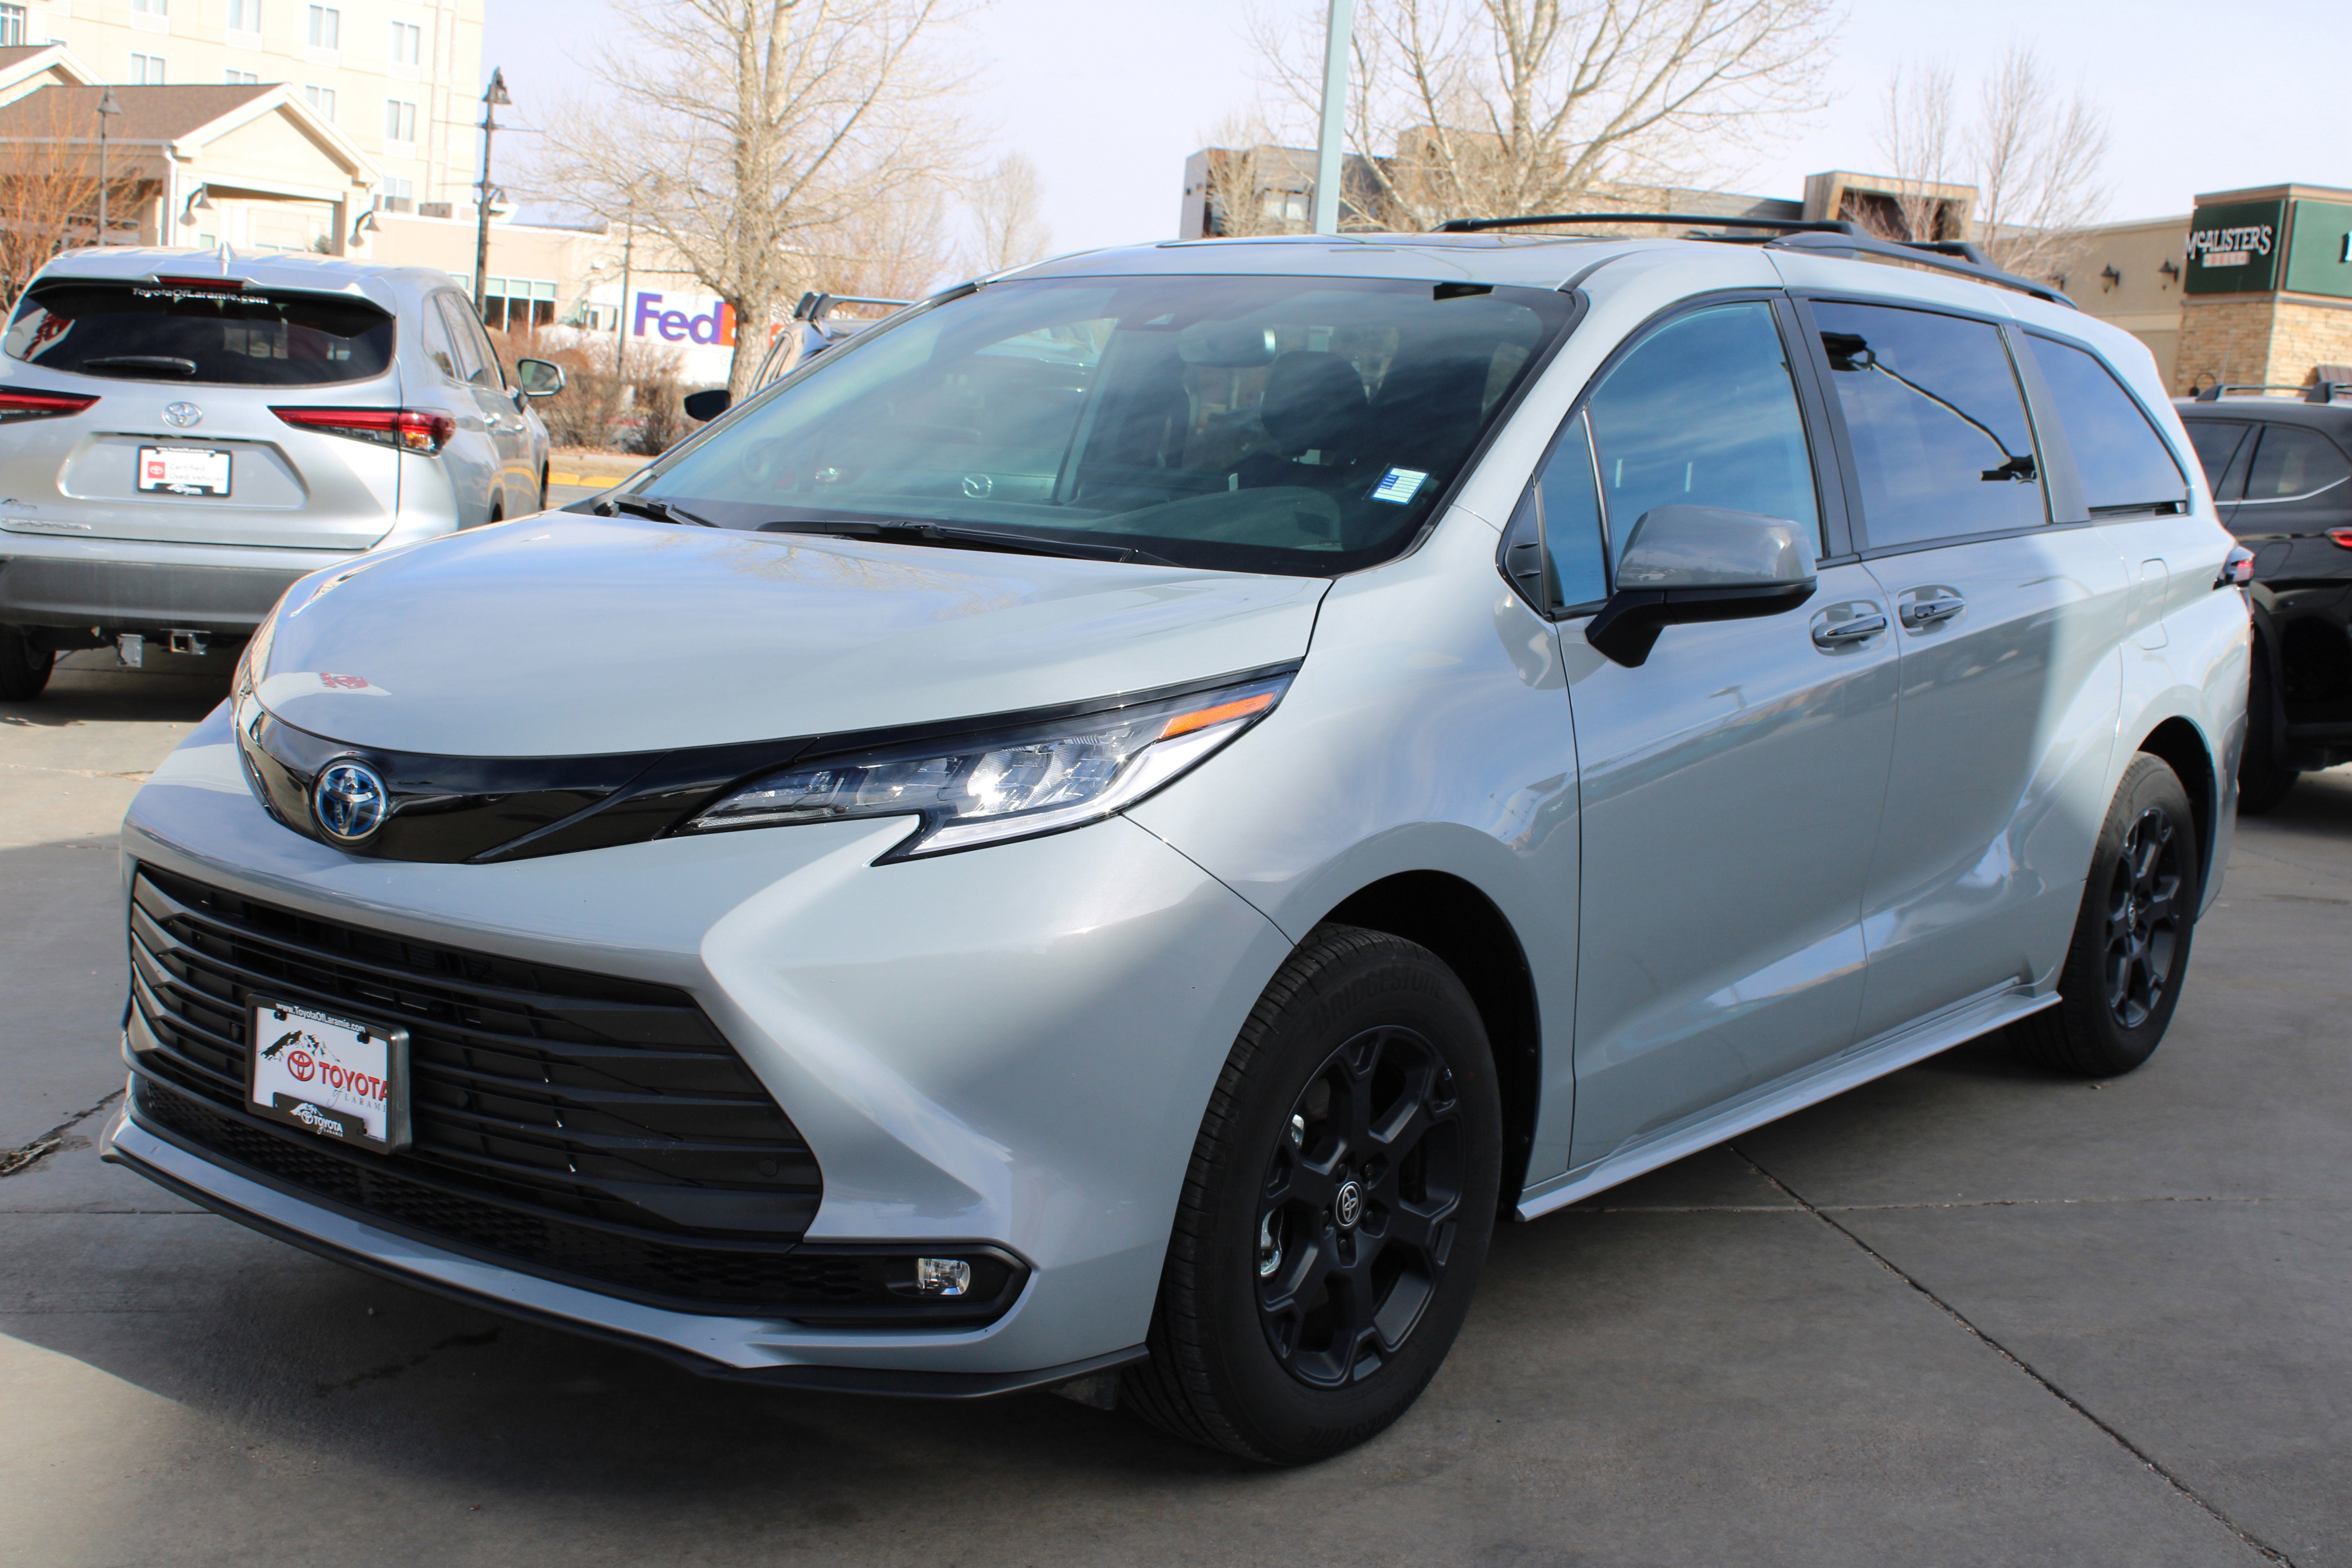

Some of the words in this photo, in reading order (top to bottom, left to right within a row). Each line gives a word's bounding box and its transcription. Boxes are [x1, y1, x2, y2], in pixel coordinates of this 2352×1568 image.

[132, 287, 269, 304] ToyotaOfLaramie.com
[275, 1003, 366, 1033] www.ToyotaOfLaramie.com
[319, 1062, 387, 1101] TOYOTA
[327, 1086, 346, 1108] of
[345, 1093, 387, 1112] LARAMI
[313, 1115, 343, 1133] TOYOTA
